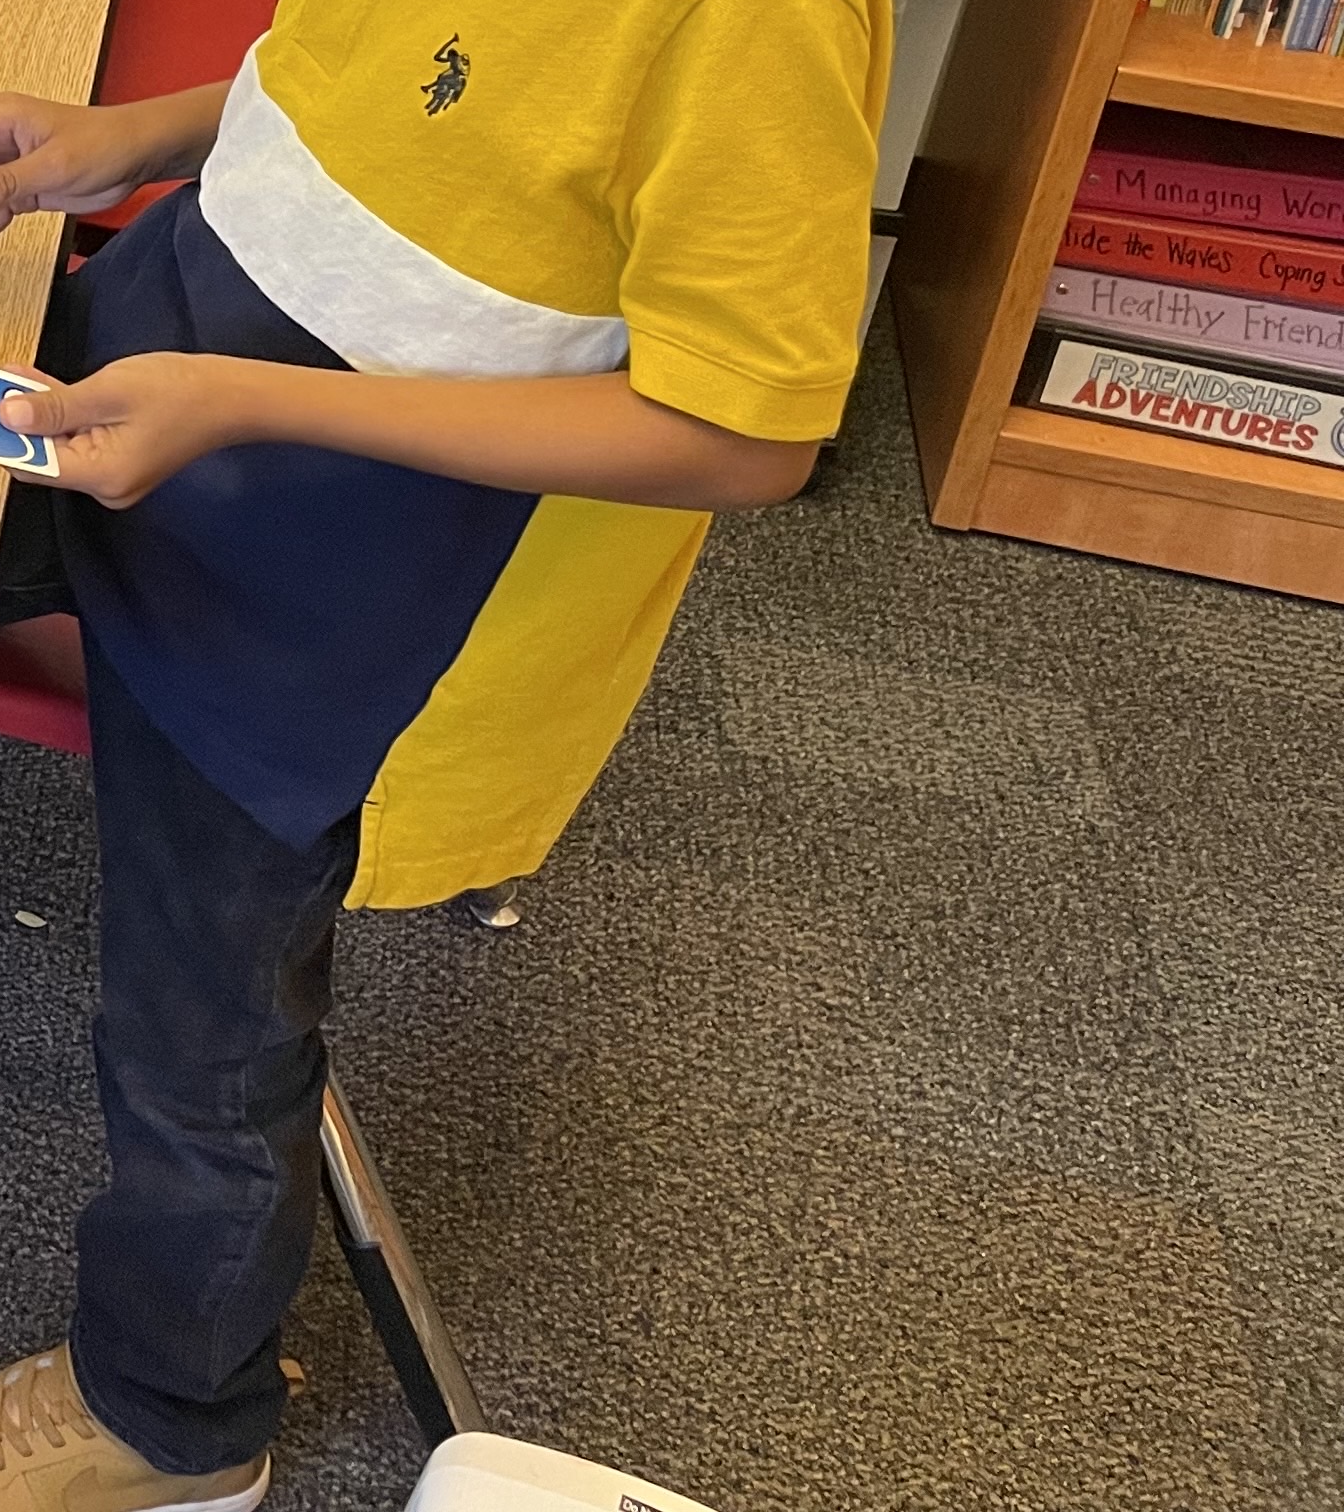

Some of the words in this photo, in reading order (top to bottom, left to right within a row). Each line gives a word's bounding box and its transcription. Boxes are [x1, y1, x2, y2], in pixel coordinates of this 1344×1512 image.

[1116, 169, 1261, 220] Managing
[1282, 188, 1344, 221] Wor
[1123, 232, 1154, 260] the
[1167, 236, 1233, 273] Waves
[1259, 251, 1326, 292] Coping
[1091, 278, 1225, 336] Healthy
[1072, 377, 1319, 451] ADVENTURES
[1089, 352, 1321, 422] FRIENDSHIP
